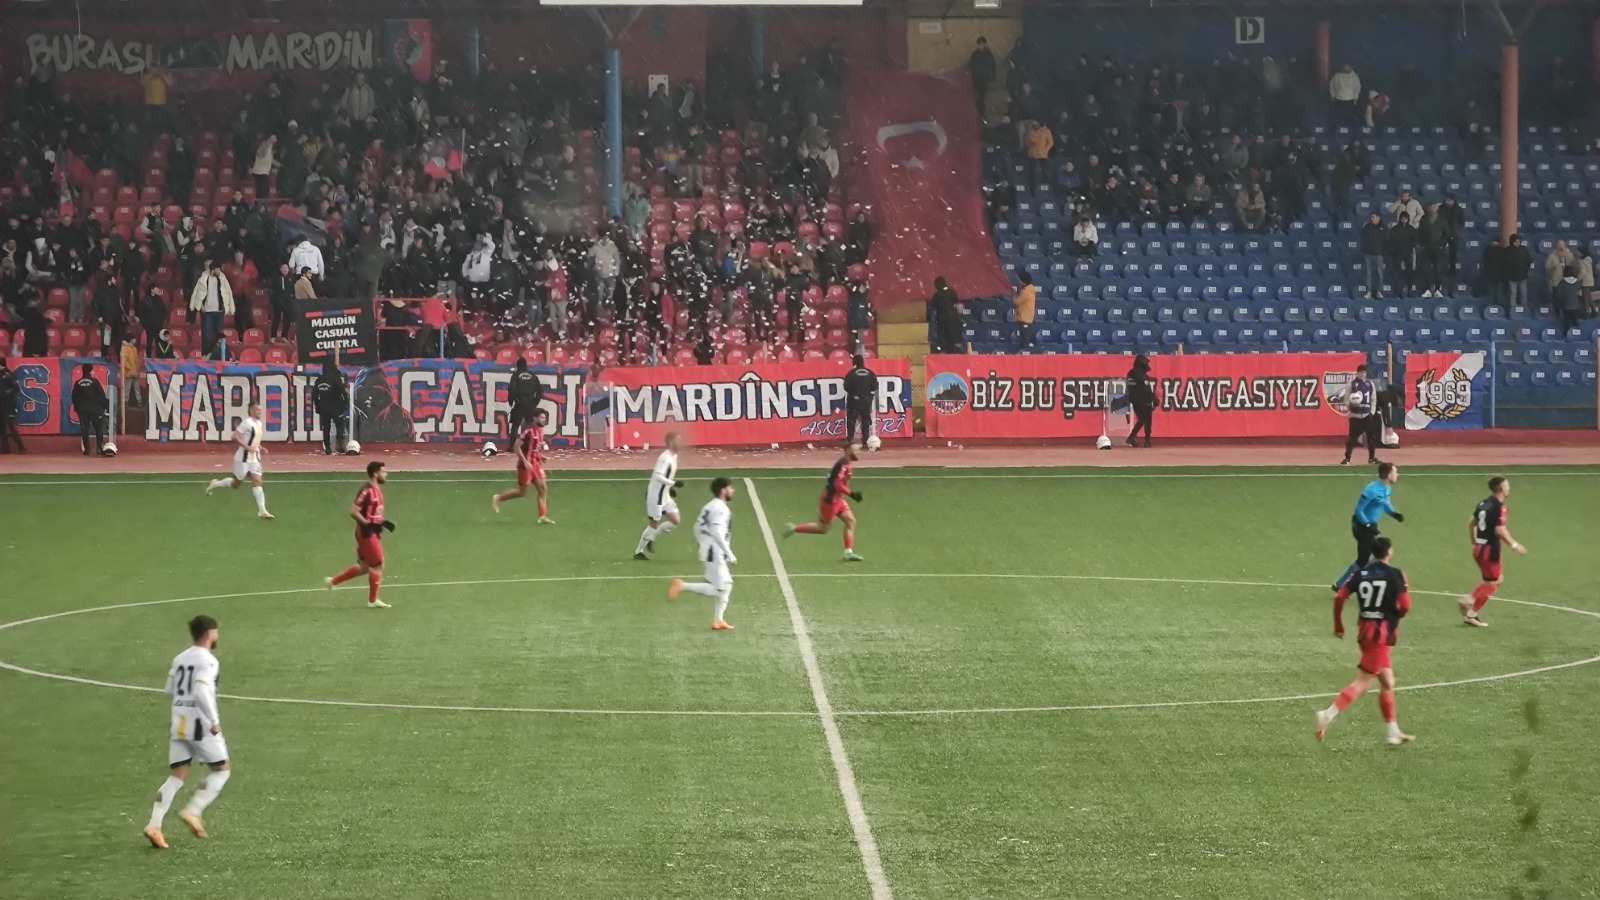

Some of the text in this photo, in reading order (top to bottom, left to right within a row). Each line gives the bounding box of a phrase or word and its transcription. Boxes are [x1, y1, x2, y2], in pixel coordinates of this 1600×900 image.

[1240, 18, 1260, 41] D
[26, 30, 373, 75] BURASI MARDİN
[311, 314, 356, 327] MARDİN
[314, 327, 357, 339] CASUAL
[613, 372, 905, 423] MARDÎNSPR
[972, 371, 1319, 417] BİZ BU ŞEH KAVGASIYIZ
[1416, 380, 1472, 408] 1969
[1359, 580, 1388, 607] 97
[176, 665, 195, 695] 21
